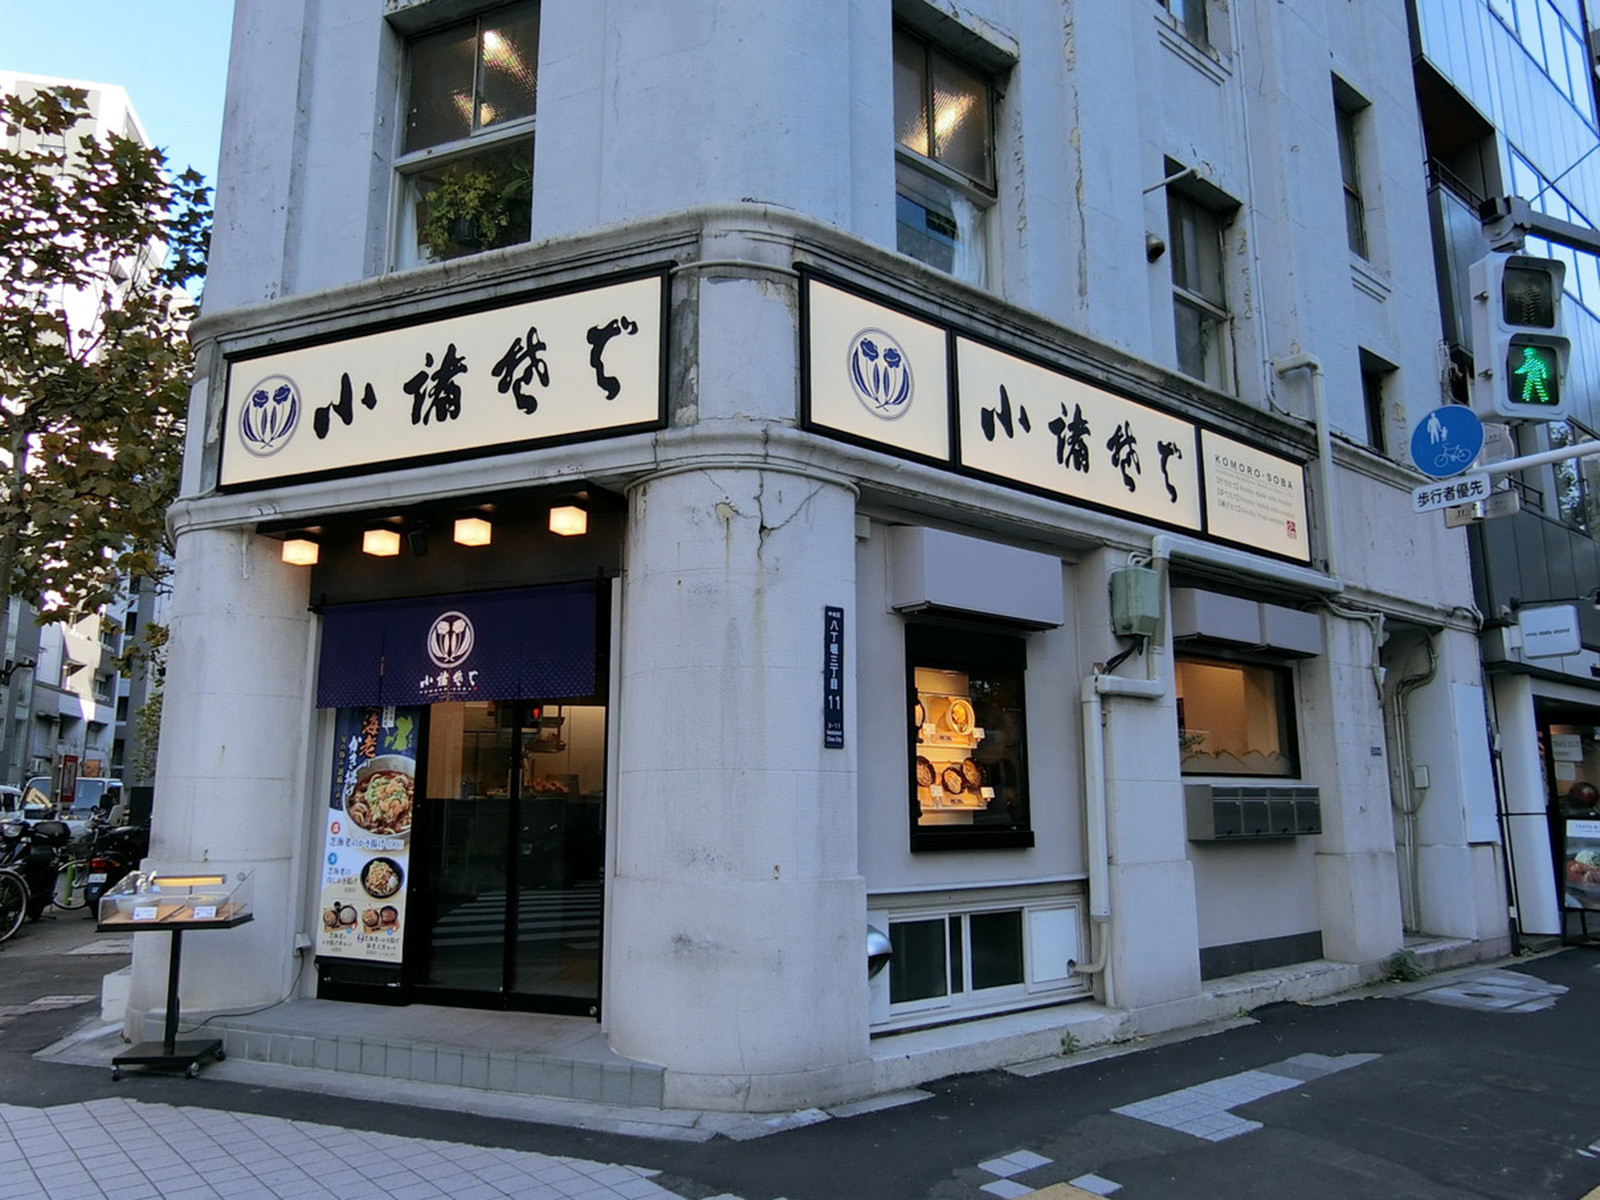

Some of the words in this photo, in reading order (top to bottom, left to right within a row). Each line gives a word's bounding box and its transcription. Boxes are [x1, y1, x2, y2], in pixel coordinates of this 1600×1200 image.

[1417, 480, 1484, 508] 歩行者優先
